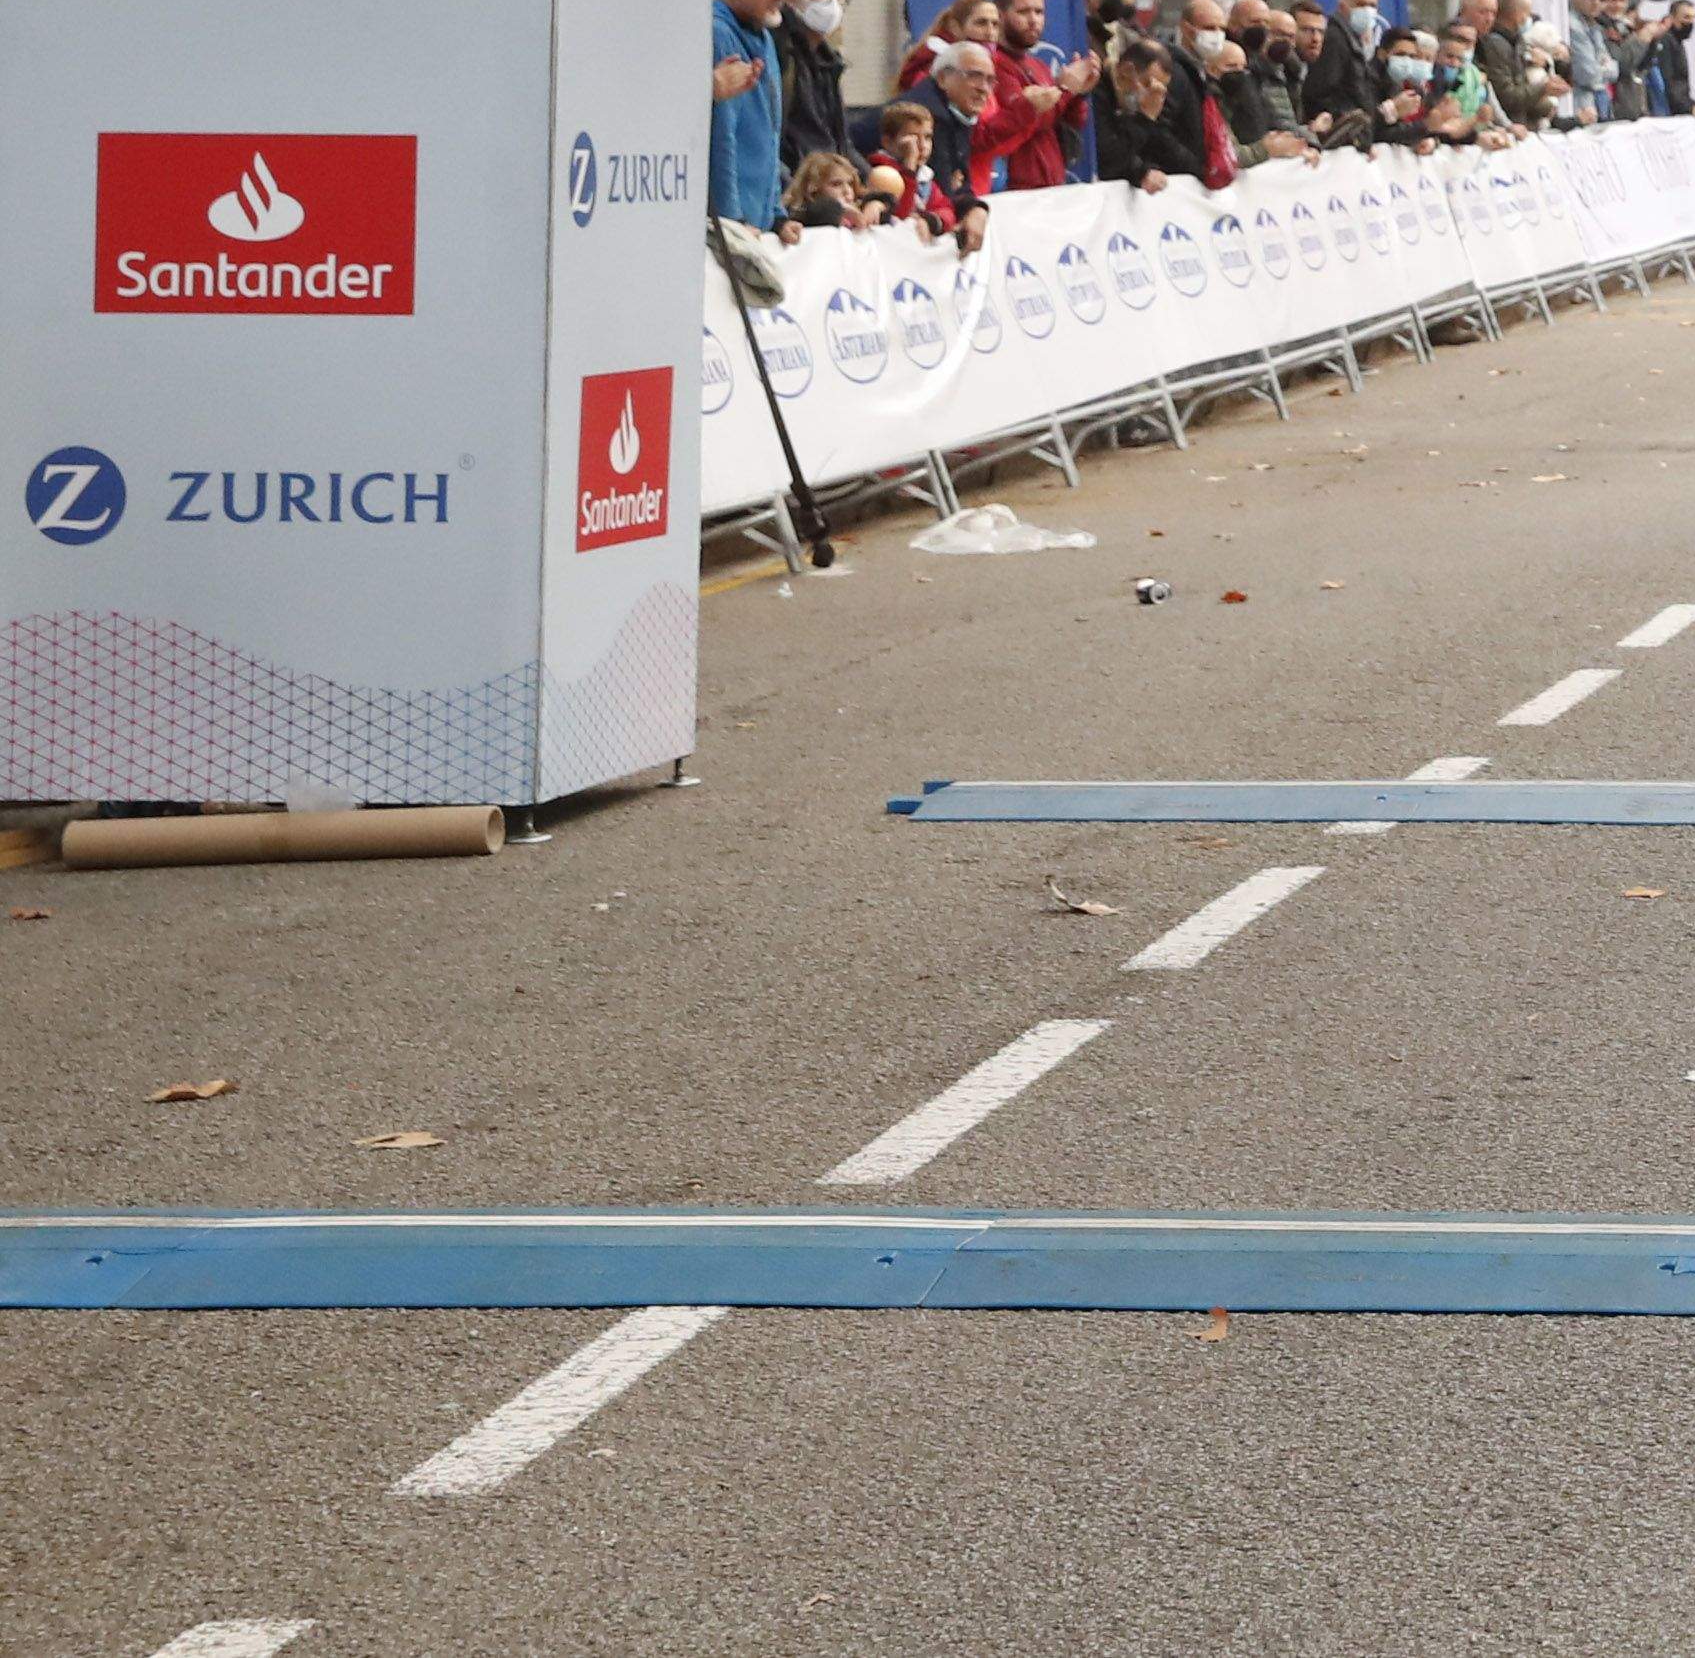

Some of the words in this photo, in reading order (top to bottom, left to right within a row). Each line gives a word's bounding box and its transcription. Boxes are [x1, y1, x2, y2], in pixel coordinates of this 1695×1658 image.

[606, 152, 688, 204] ZURICH
[115, 250, 392, 300] Santander
[165, 471, 449, 525] ZURICH
[579, 481, 664, 536] Santander
